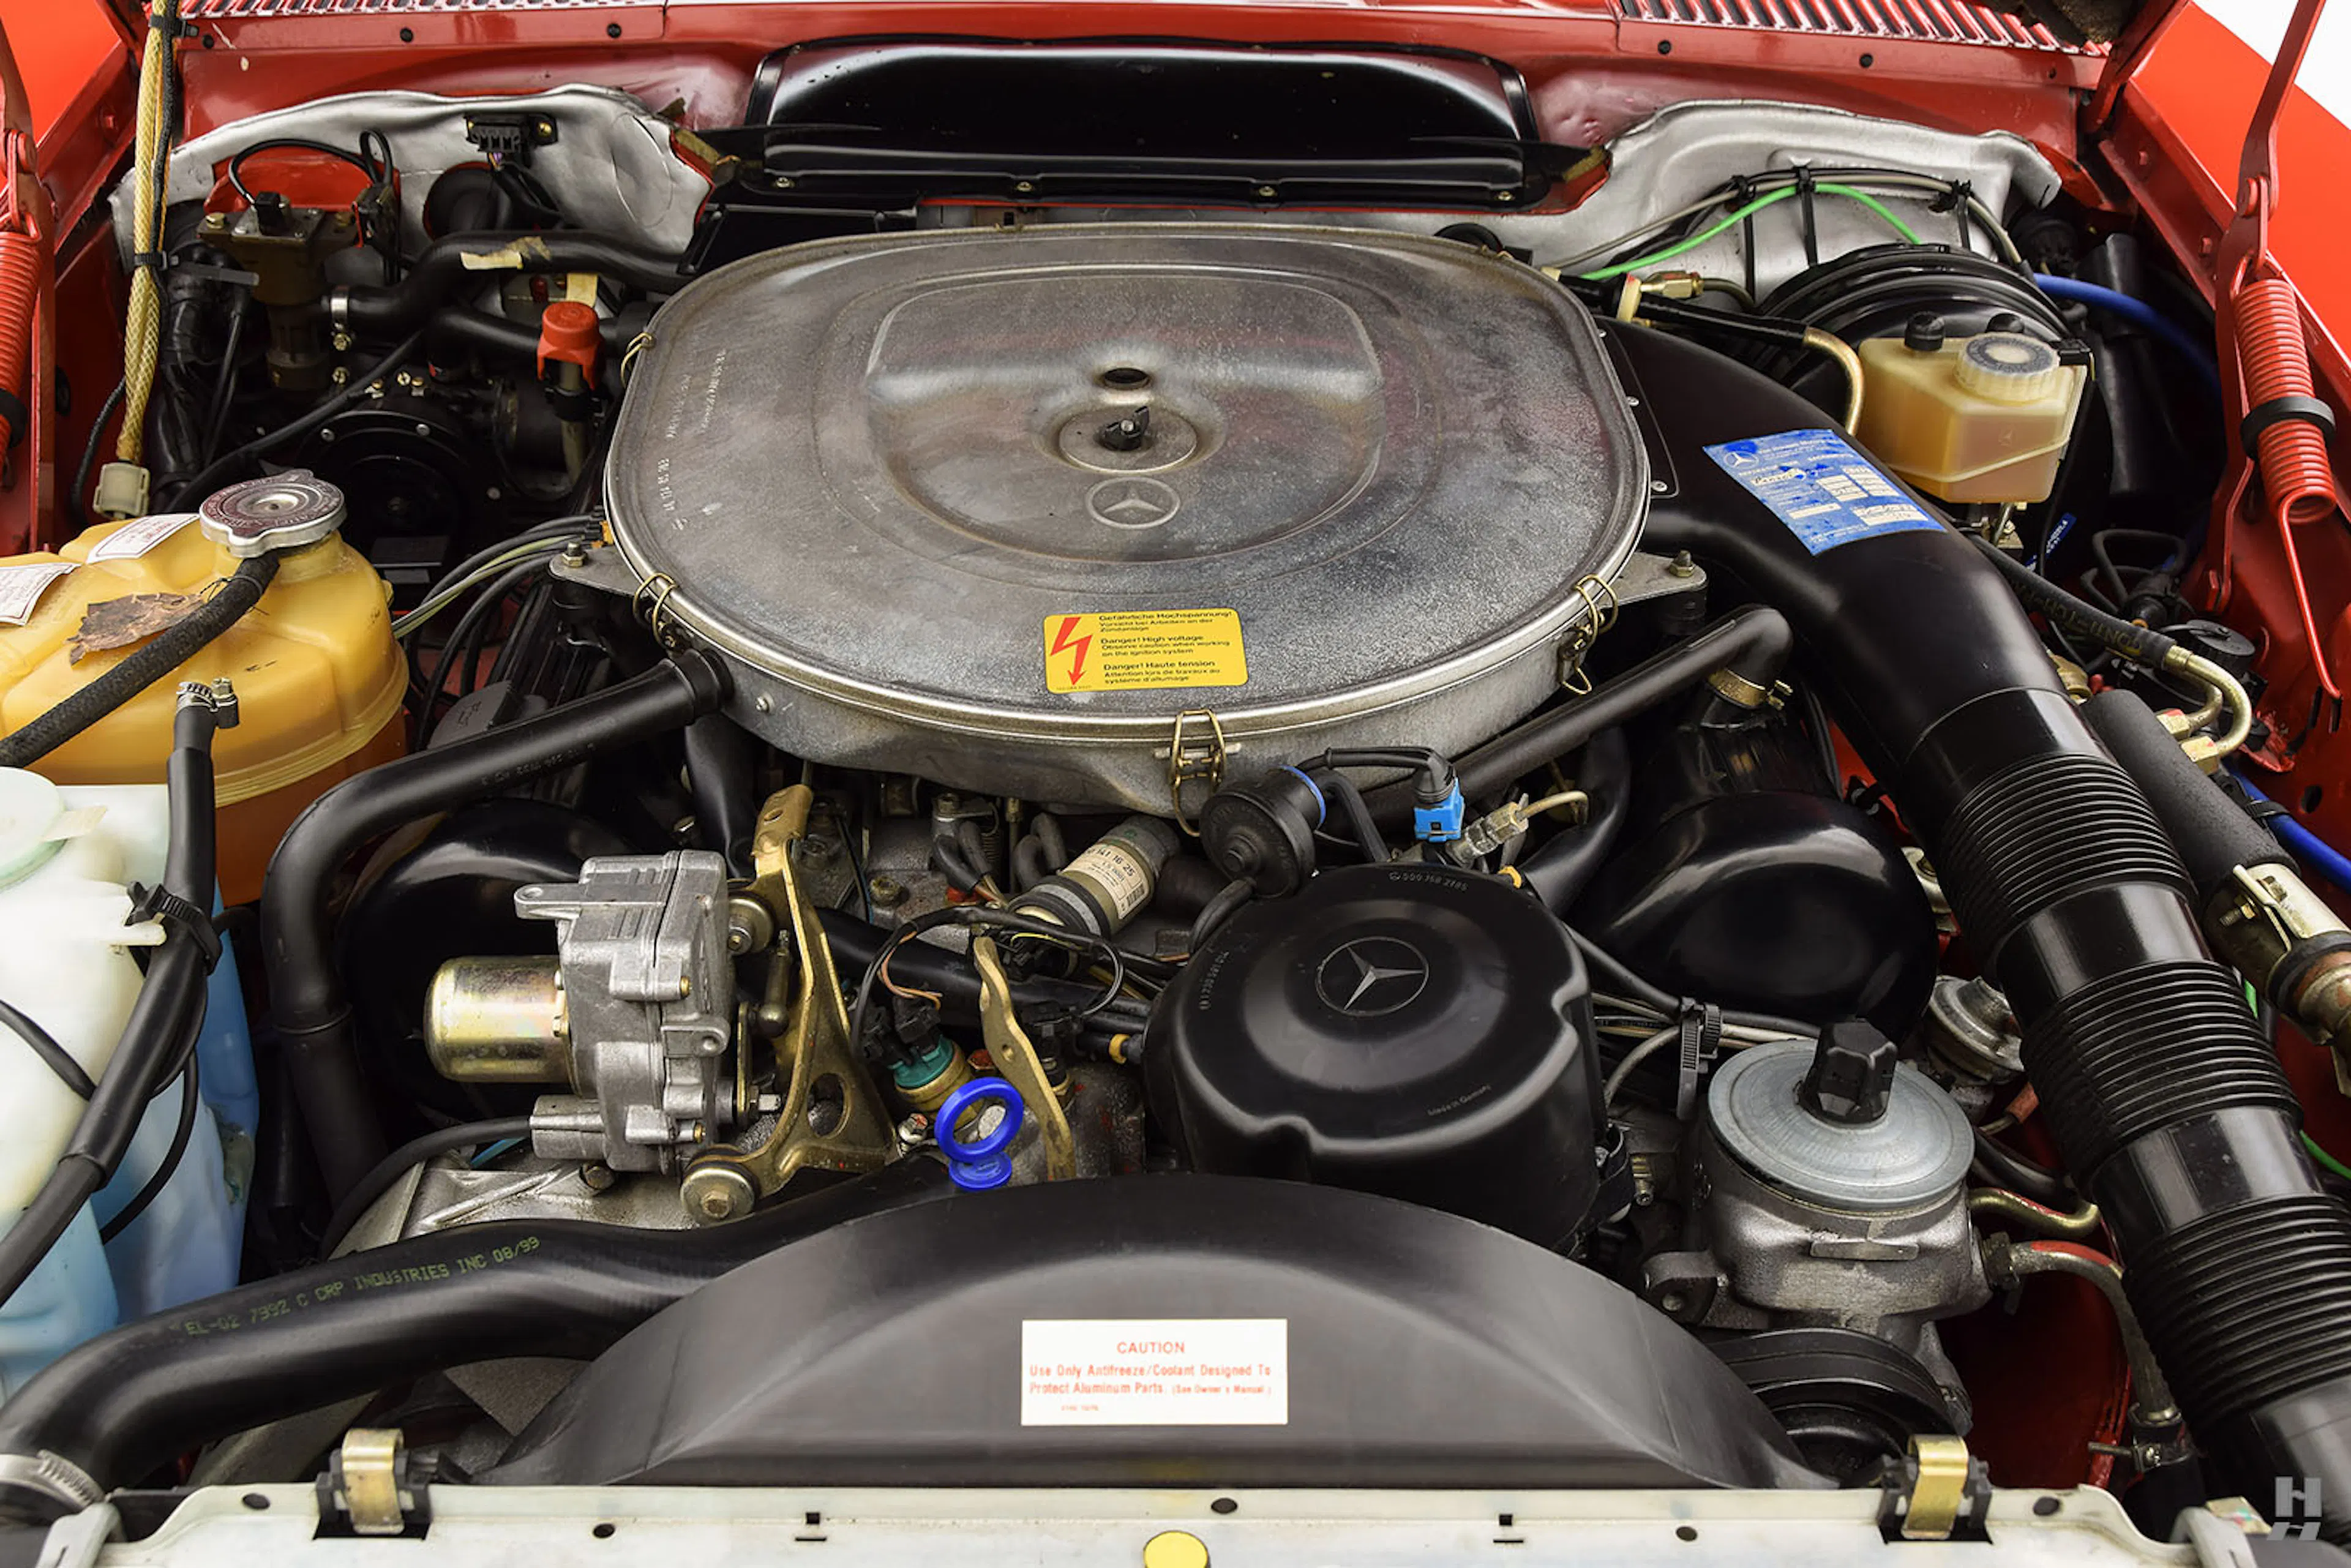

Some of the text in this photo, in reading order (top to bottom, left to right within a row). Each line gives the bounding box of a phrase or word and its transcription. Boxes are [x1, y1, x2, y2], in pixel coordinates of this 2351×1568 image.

[1104, 662, 1144, 671] Danger!
[1122, 863, 1136, 877] 25
[315, 1281, 343, 1302] CRP
[353, 1262, 450, 1290] INDUSTRIES
[457, 1254, 488, 1274] INC
[492, 1236, 541, 1264] 08/99
[1117, 1341, 1185, 1354] CAUTION
[1030, 1364, 1272, 1379] Use Only Antifreeze/Coolant Designed To
[1030, 1382, 1070, 1395] Protect
[1073, 1382, 1131, 1394] Aluminum
